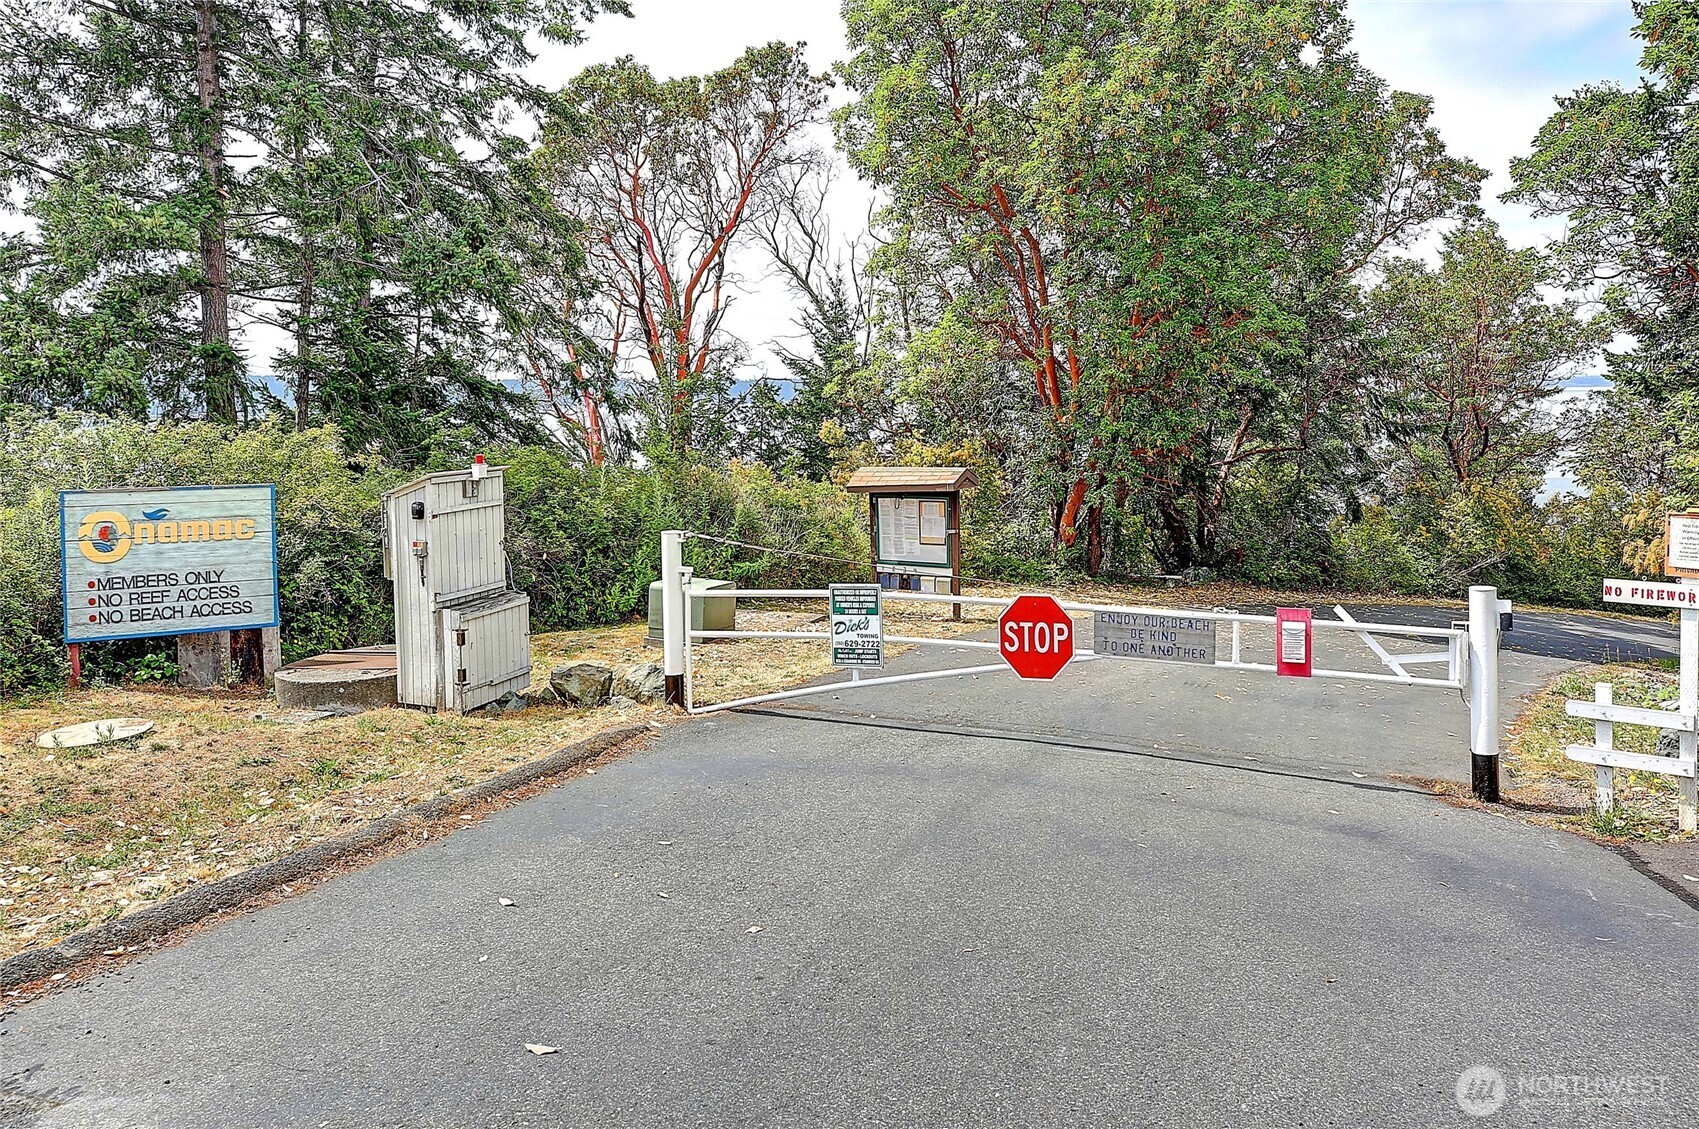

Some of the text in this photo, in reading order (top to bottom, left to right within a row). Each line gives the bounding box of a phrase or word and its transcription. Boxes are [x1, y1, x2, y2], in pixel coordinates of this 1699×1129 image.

[78, 510, 256, 564] Onamac
[97, 569, 225, 591] MEMBERS ONLY
[98, 585, 240, 608] NO REEF ACCESS
[1604, 585, 1697, 604] NO FIREWOR
[99, 601, 253, 625] NO BEACH ACCESS
[1100, 612, 1210, 631] ENJOY OUR BEACH
[834, 617, 870, 635] Dick's
[1130, 629, 1177, 642] BE KIND
[844, 640, 880, 648] 629-2722
[1004, 621, 1069, 653] STOP
[1103, 640, 1207, 659] TO ONE ANOTHER
